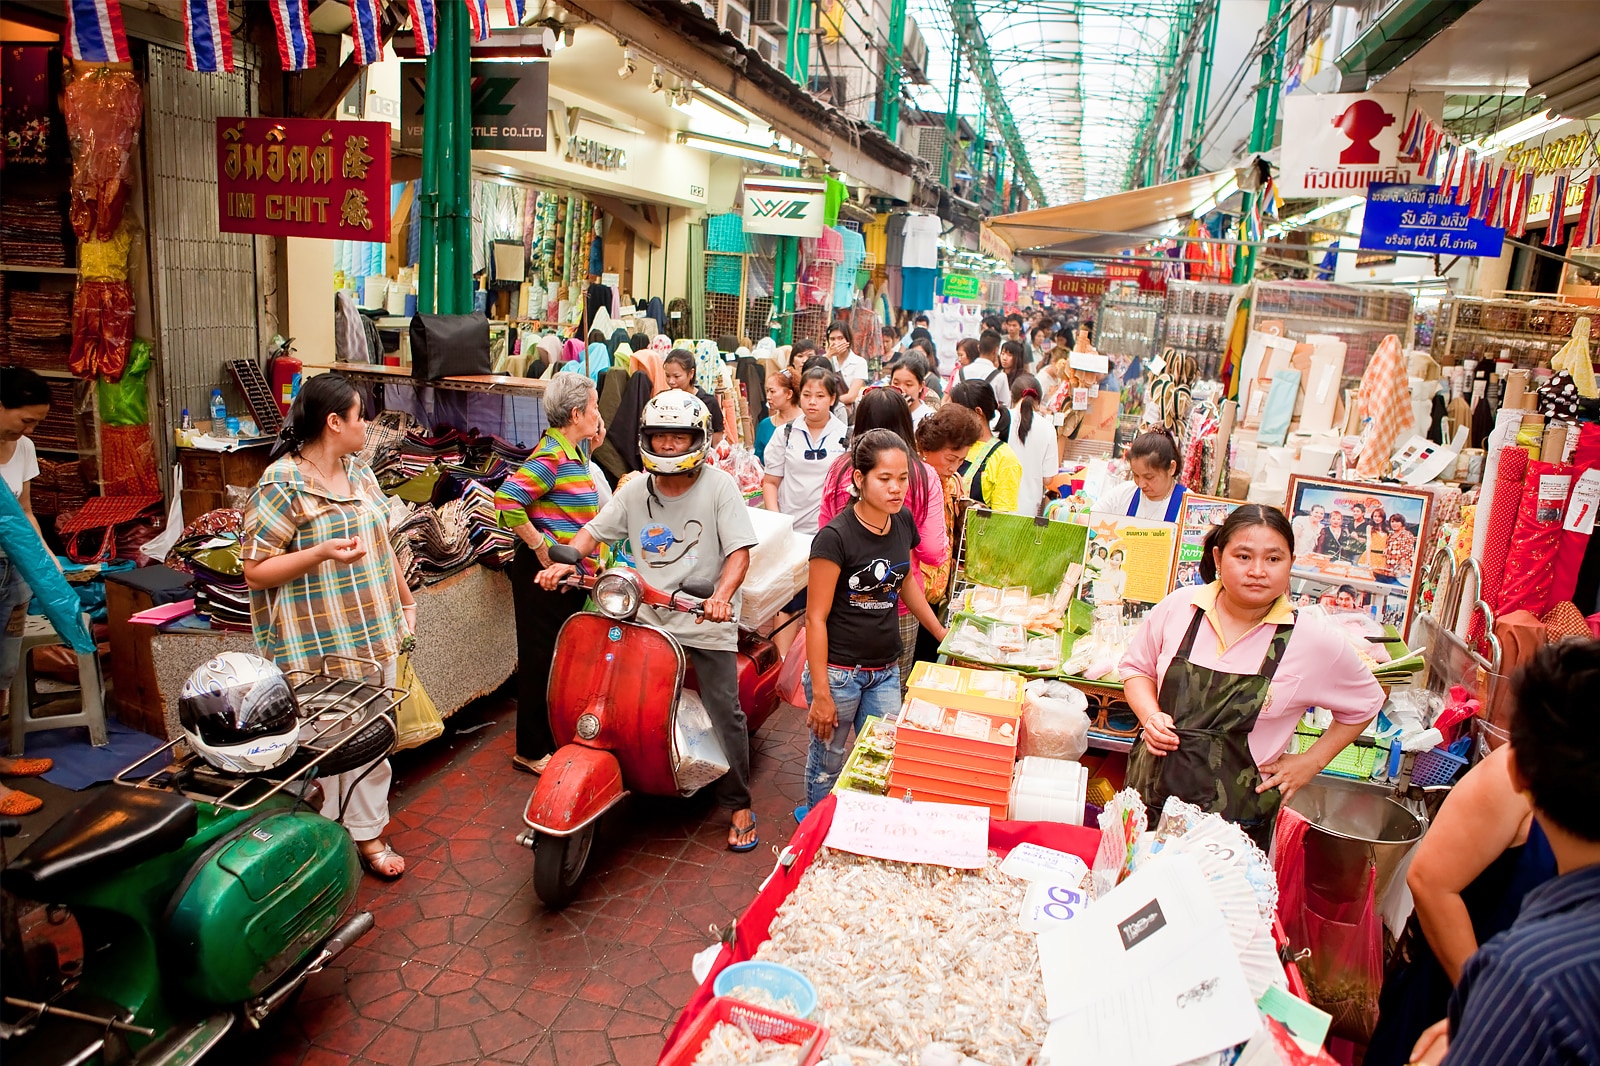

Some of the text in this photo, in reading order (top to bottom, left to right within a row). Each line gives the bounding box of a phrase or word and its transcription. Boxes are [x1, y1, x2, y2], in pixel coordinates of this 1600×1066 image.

[227, 192, 330, 223] IM CHIT
[1043, 886, 1081, 921] 50
